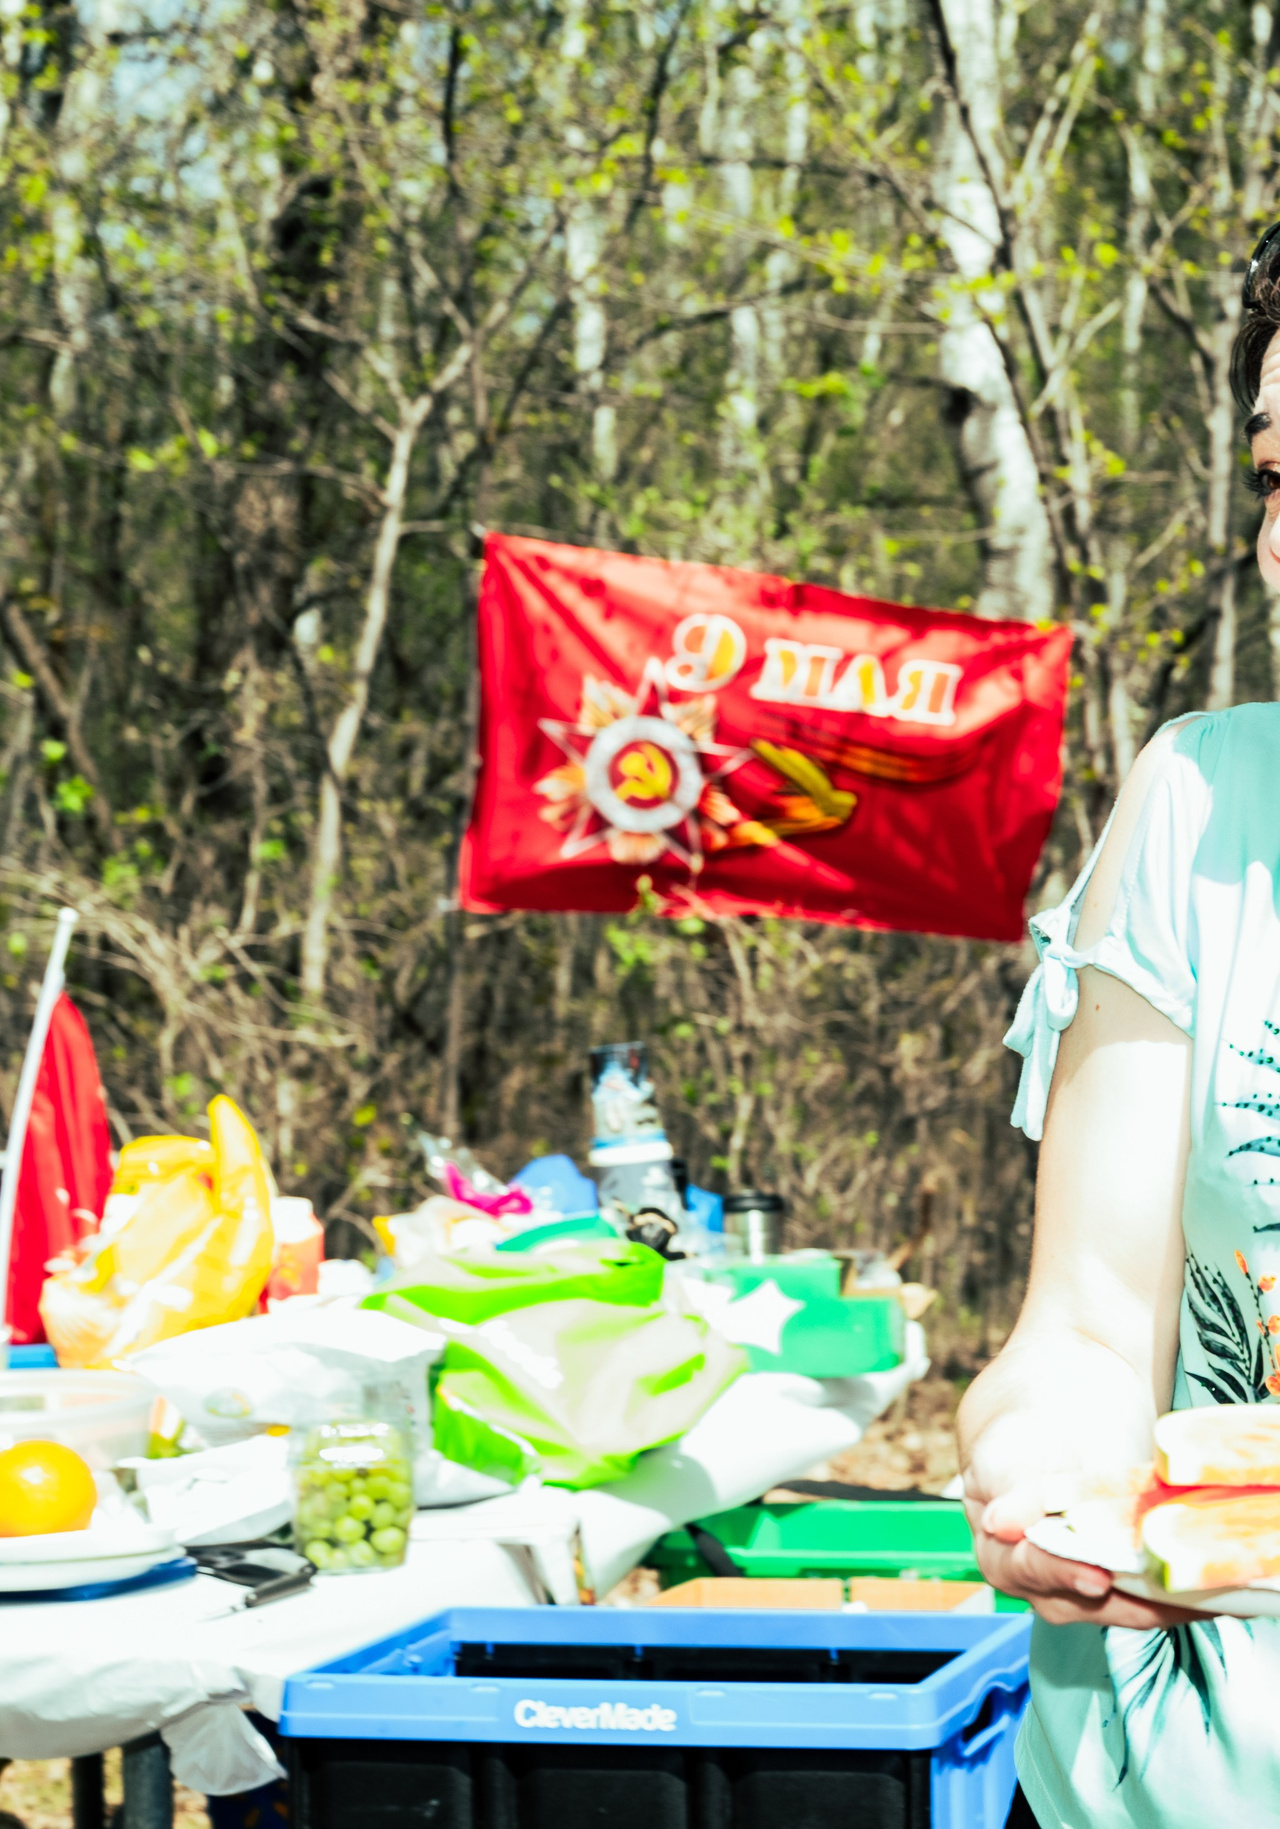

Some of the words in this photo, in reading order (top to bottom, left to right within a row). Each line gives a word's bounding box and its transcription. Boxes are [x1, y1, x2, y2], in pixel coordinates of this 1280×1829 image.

[665, 613, 747, 693] 9
[751, 638, 963, 726] МАЯ
[514, 1699, 677, 1731] CleverMade
